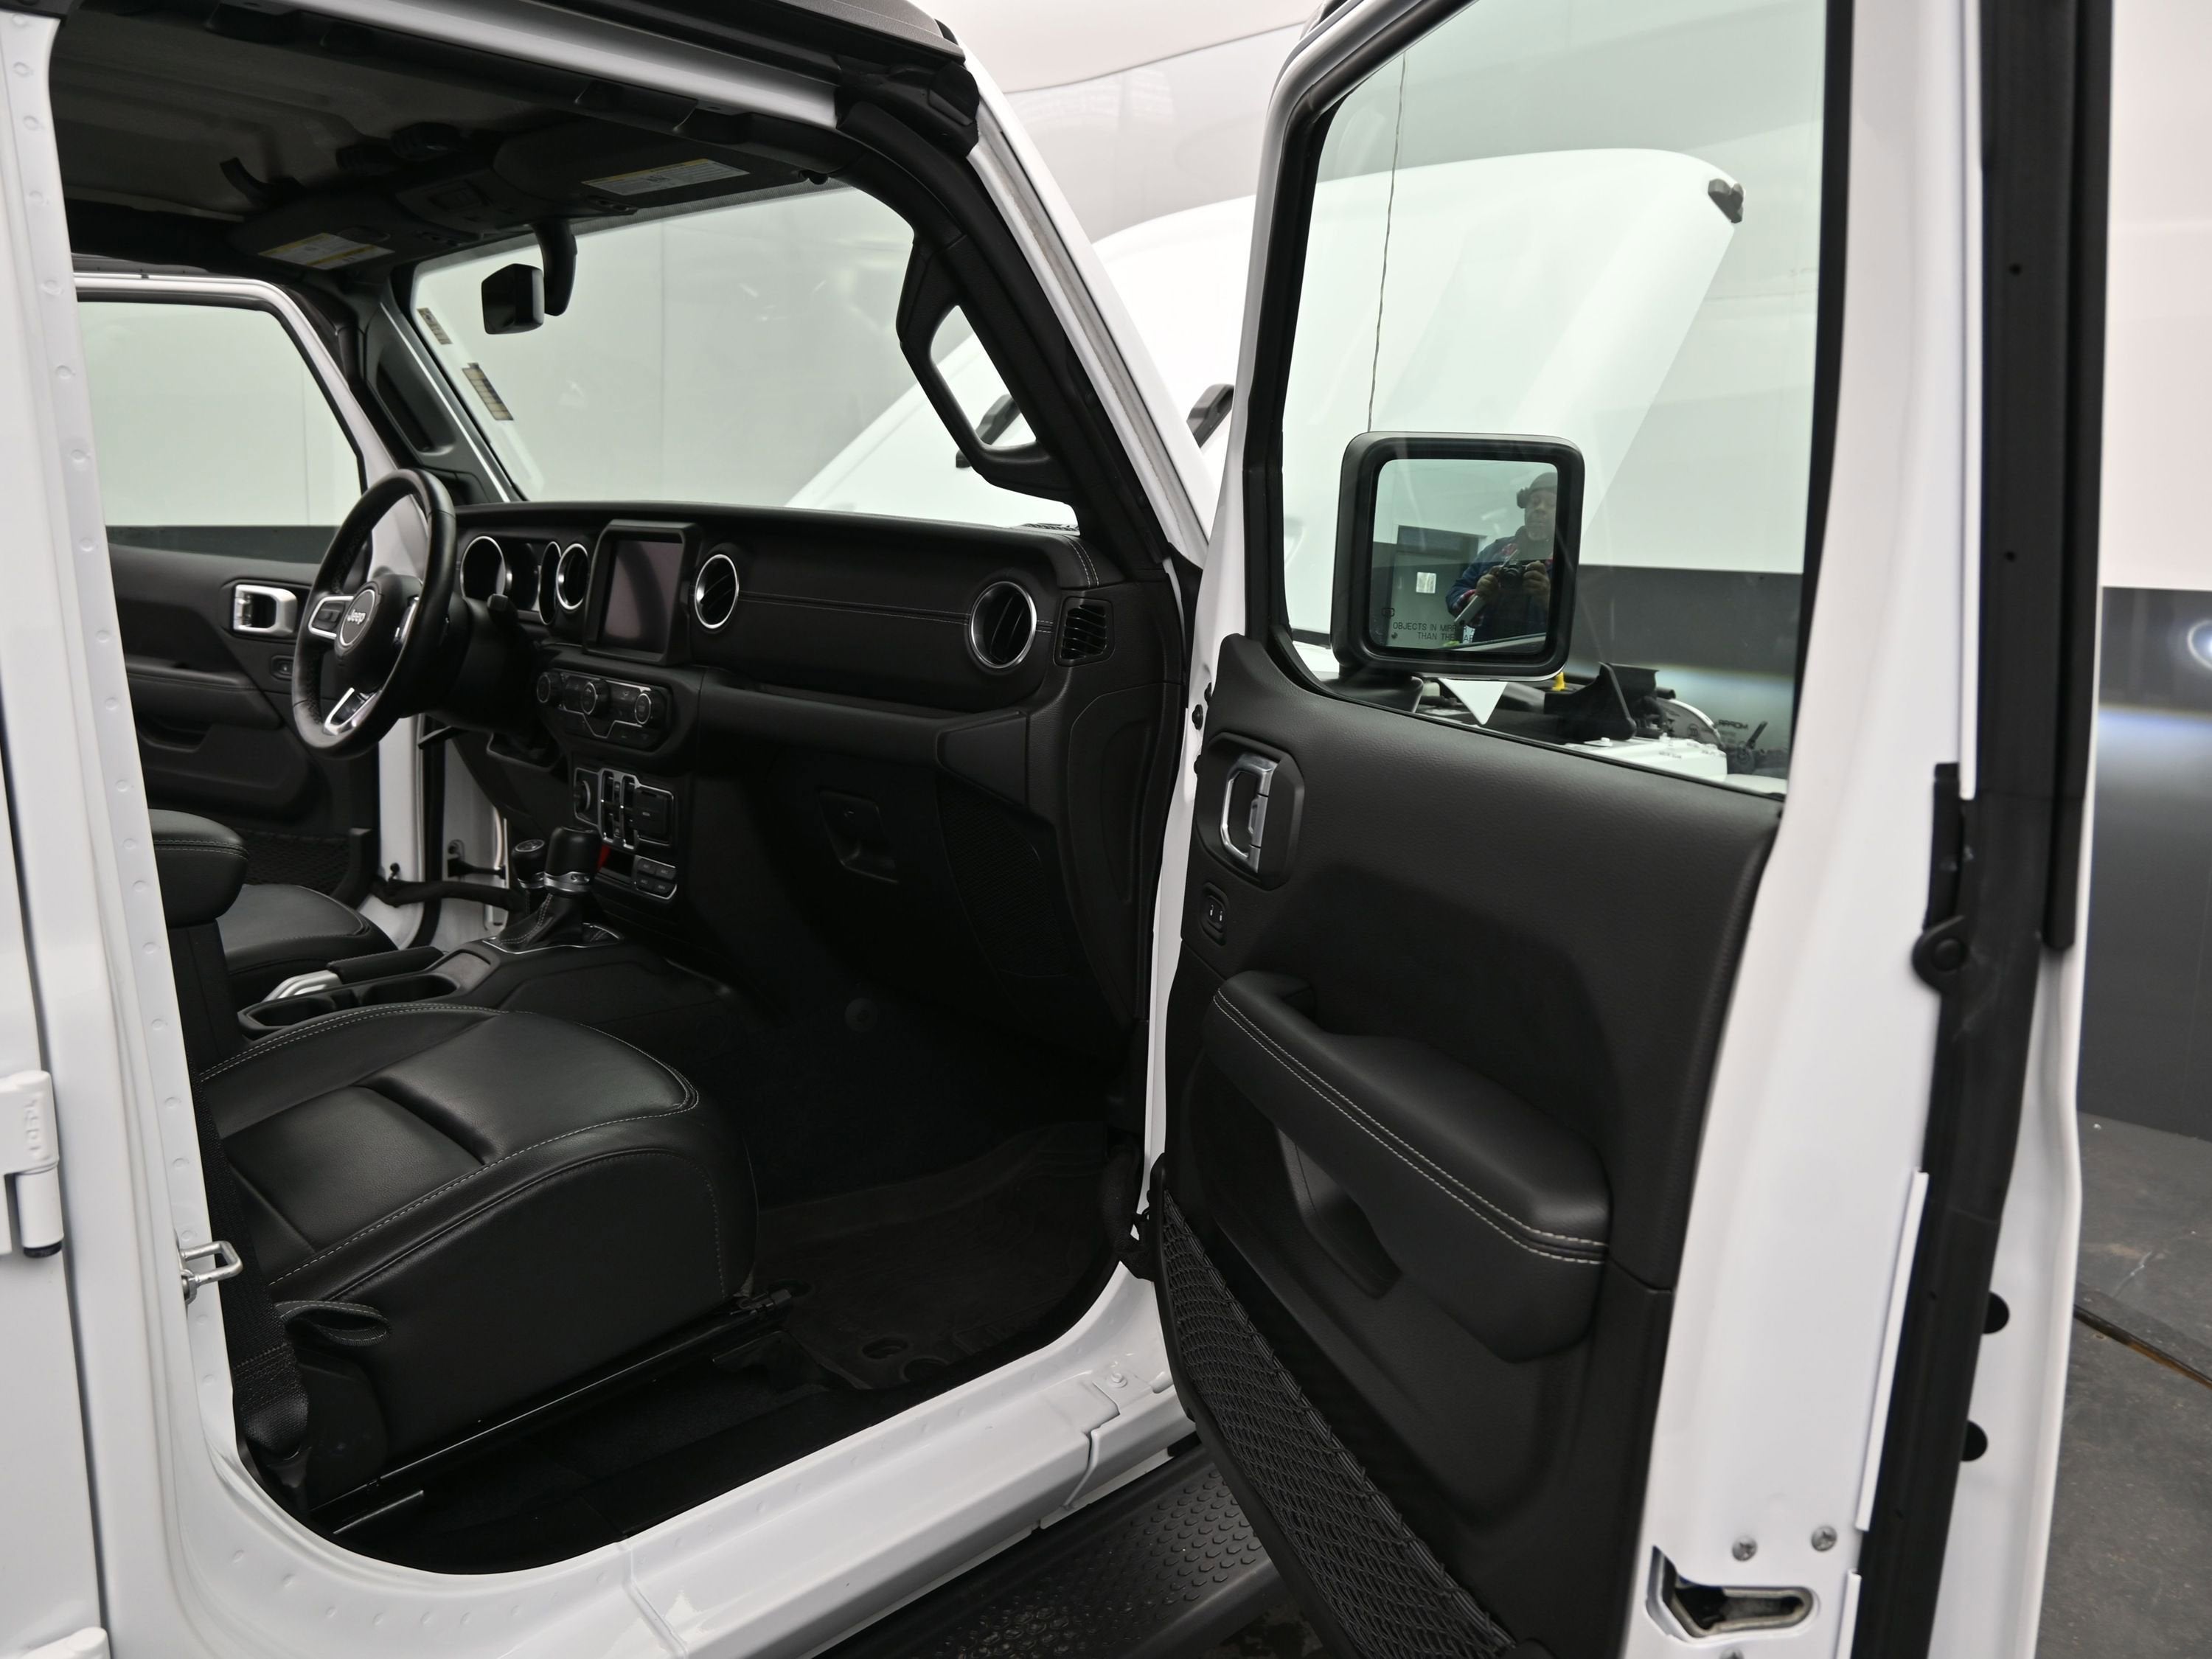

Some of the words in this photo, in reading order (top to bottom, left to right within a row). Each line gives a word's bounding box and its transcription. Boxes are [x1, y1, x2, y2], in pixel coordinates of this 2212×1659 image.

[347, 609, 366, 625] Jeep
[1392, 622, 1427, 631] OBJECTS
[1417, 632, 1438, 640] THAN
